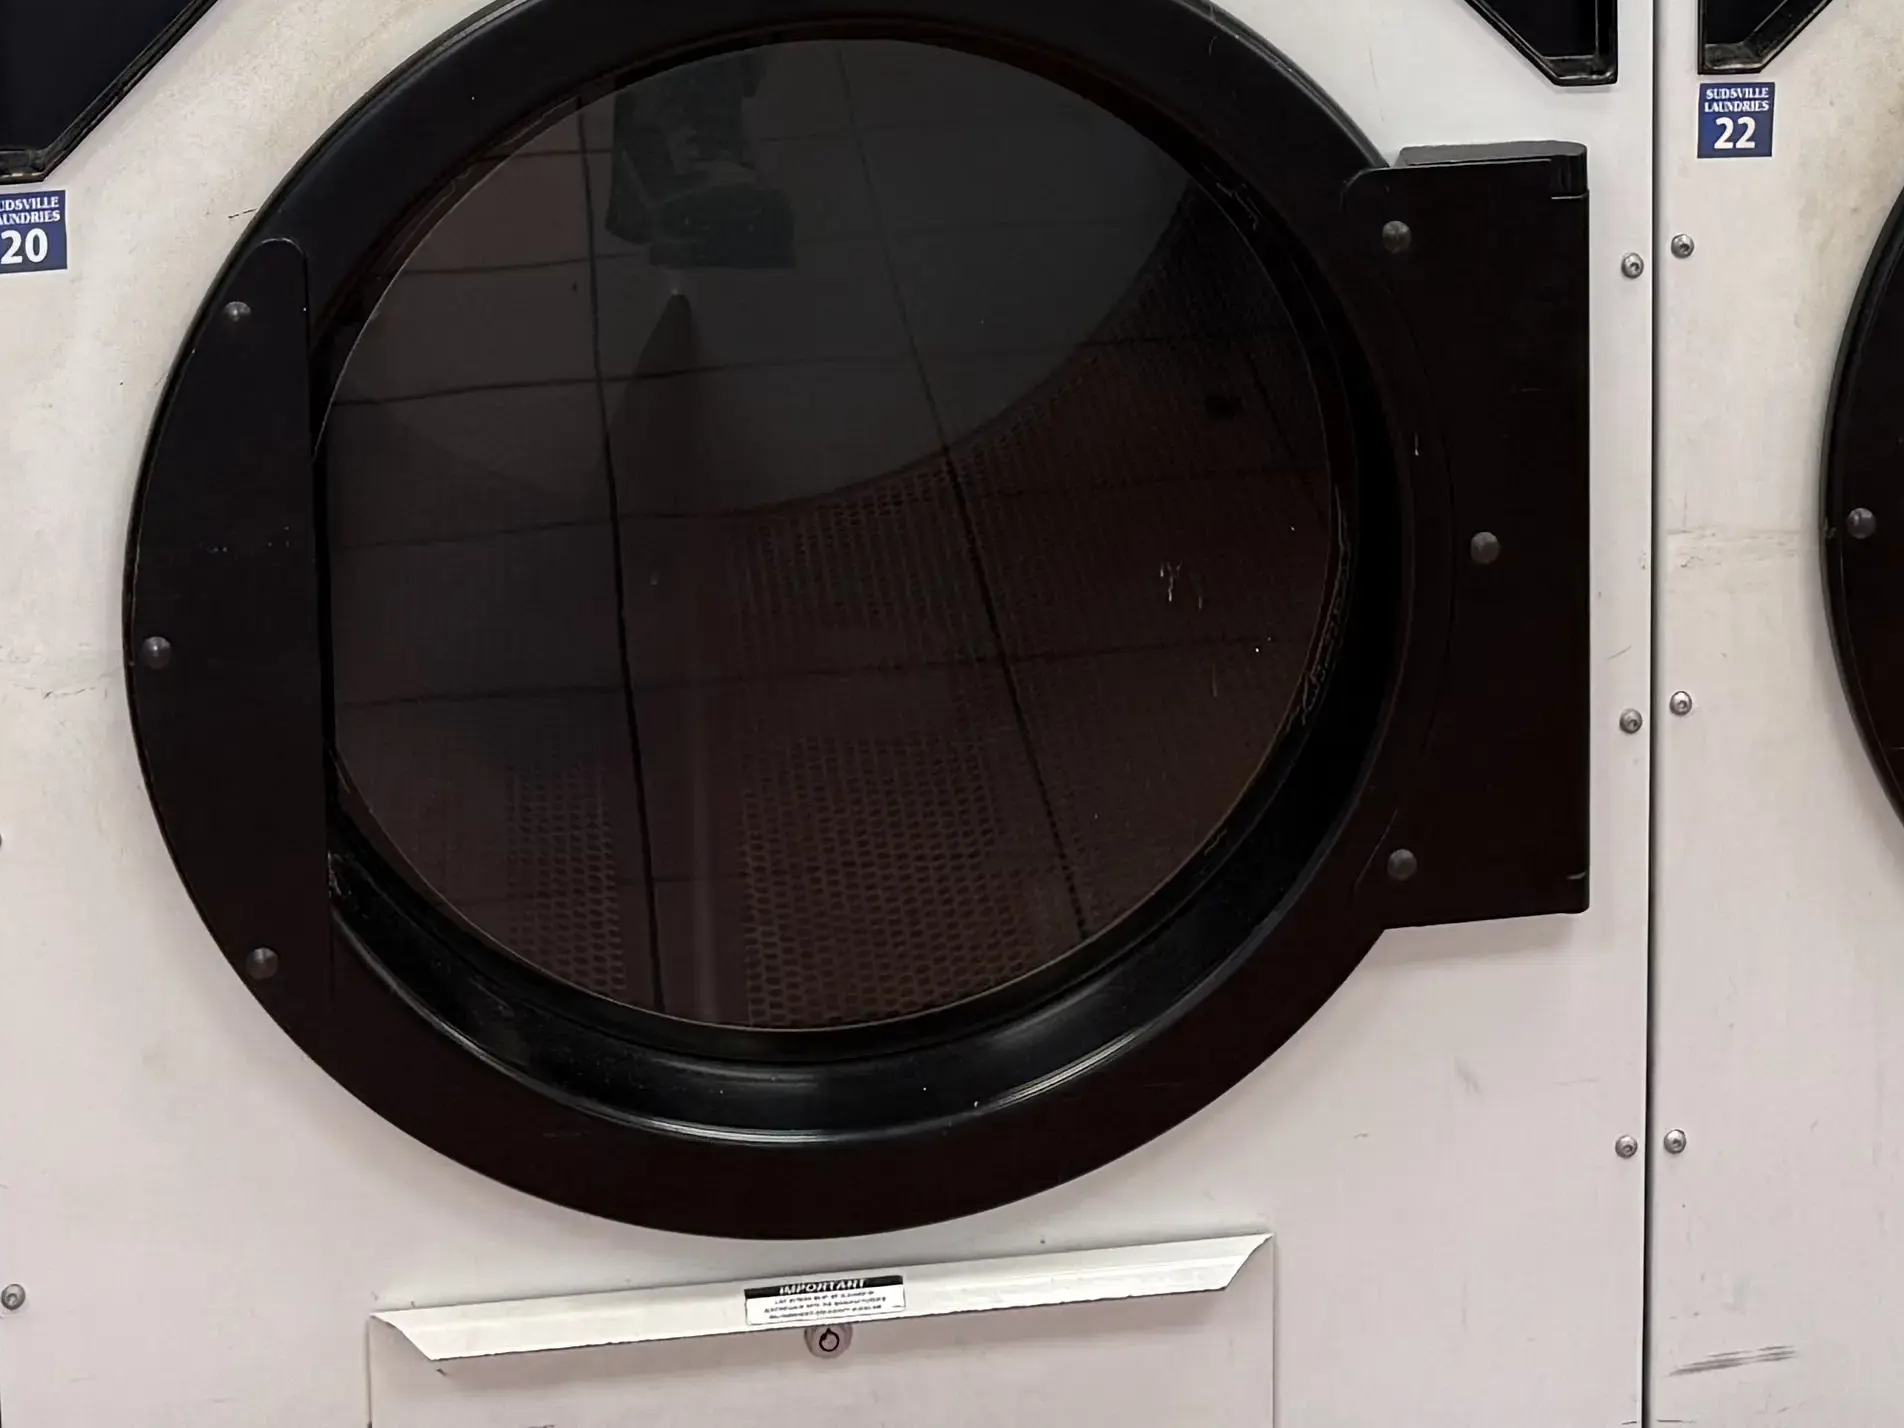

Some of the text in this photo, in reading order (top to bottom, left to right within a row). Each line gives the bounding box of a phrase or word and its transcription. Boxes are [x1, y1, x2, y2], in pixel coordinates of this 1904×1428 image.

[1706, 87, 1769, 100] SUDSVILLE
[1704, 100, 1770, 113] LAUNDRIES
[1713, 116, 1756, 149] 22
[0, 227, 48, 265] 20
